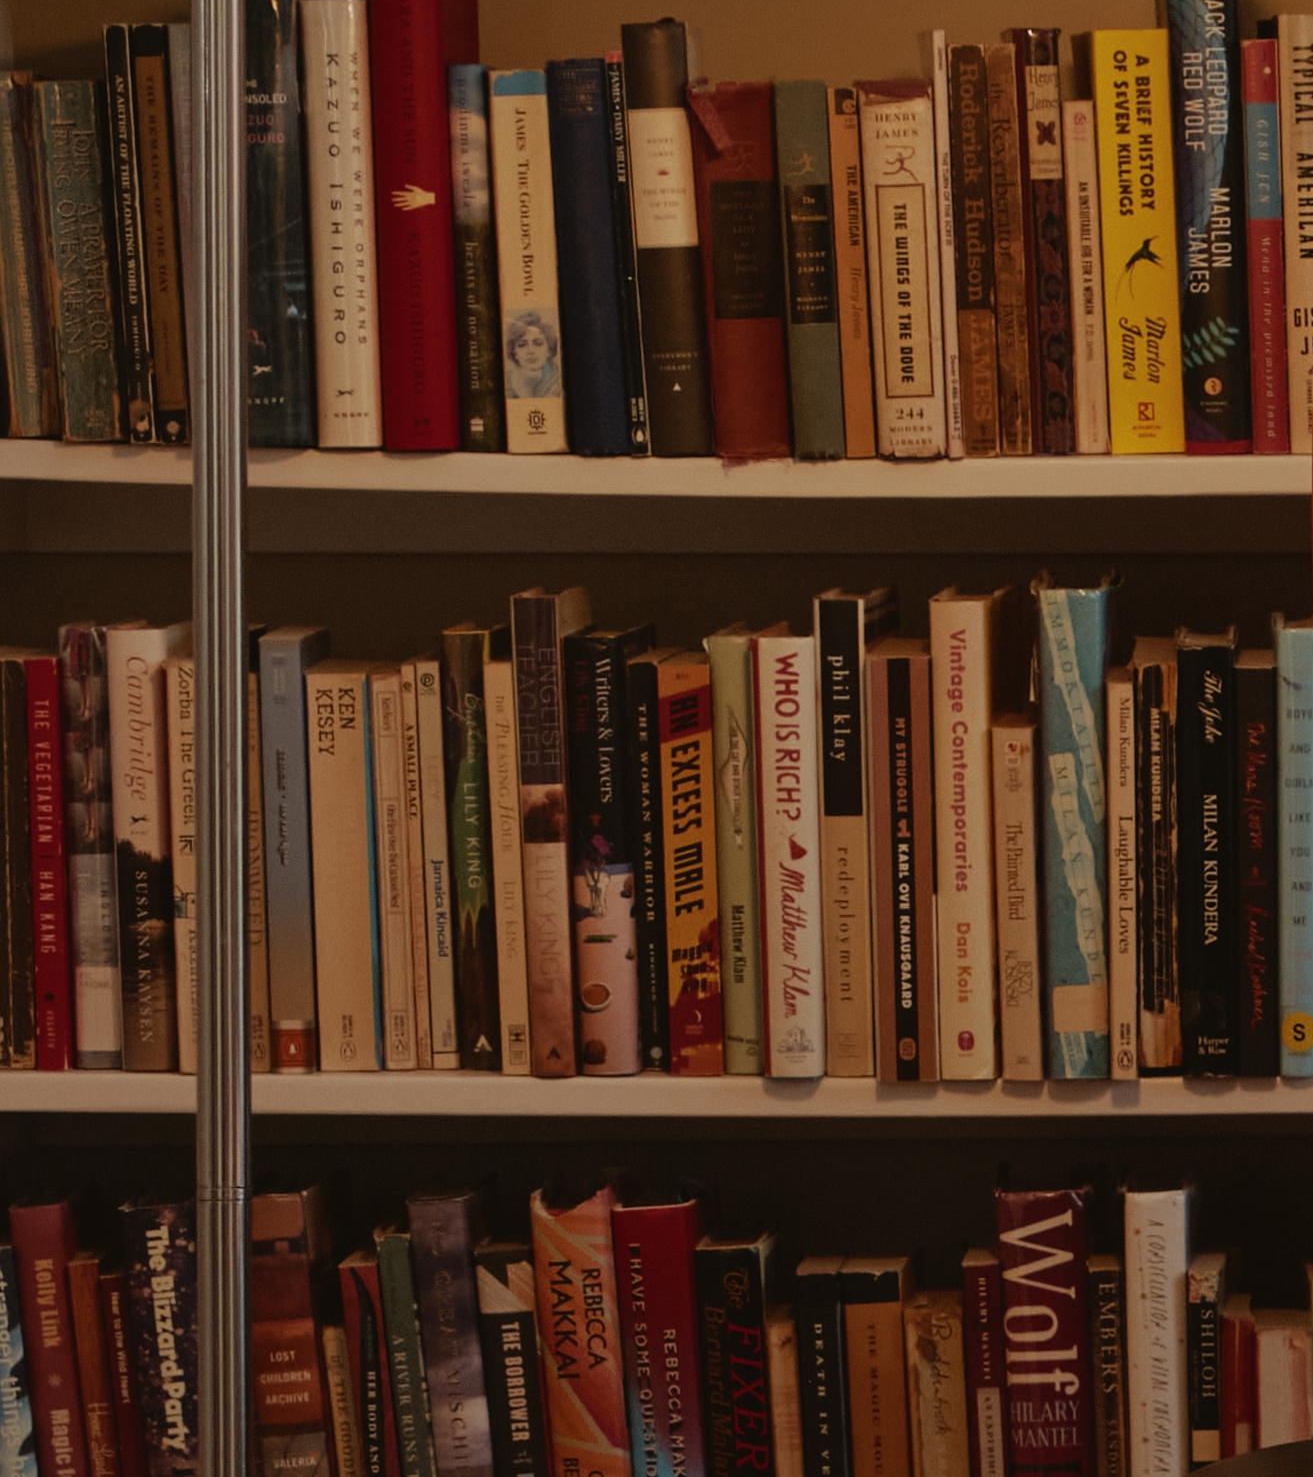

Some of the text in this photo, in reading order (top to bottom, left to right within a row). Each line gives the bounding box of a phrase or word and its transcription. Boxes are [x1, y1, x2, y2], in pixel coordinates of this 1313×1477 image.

[1114, 51, 1128, 72] OF
[1182, 52, 1205, 151] RED WOLF
[1206, 46, 1228, 135] LEOPARD
[958, 63, 986, 302] Roderick Hudson
[1135, 55, 1155, 211] A BRIEF HISTORY
[326, 53, 346, 346] KAZUO ISHIGURO
[1188, 227, 1210, 294] JAMES
[1210, 187, 1232, 268] MARLON
[894, 203, 914, 383] THE WINGS OF THE DOVE
[1118, 317, 1143, 381] James
[1145, 316, 1168, 384] Marlon
[315, 688, 335, 757] KESEY
[338, 687, 356, 730] KEN
[774, 653, 802, 822] WHO IS RICH?
[827, 655, 851, 763] phil klay
[34, 699, 56, 954] THE VEGETARIAN HAN KANG
[668, 695, 704, 917] AN EXCESS MALE
[947, 629, 974, 1004] Vintage Contemporaries Dan Kois
[1202, 794, 1219, 945] MILAN KUNDERA
[778, 863, 810, 1019] Matthew Klam
[833, 846, 856, 1003] redeployment
[897, 843, 913, 1009] KARL OVE KNAUSGAARD
[1115, 816, 1133, 954] Laughable Loves
[33, 1259, 61, 1348] Kelly Link
[144, 1226, 190, 1451] The Blizzard Party
[548, 1261, 579, 1380] MAKKAI
[581, 1268, 606, 1369] REBECCA
[999, 1209, 1080, 1395] Wolf
[1097, 1283, 1120, 1395] EMBERS
[1200, 1309, 1216, 1398] SHILOH
[501, 1322, 530, 1442] THE BORROWER
[726, 1322, 769, 1472] FIXER
